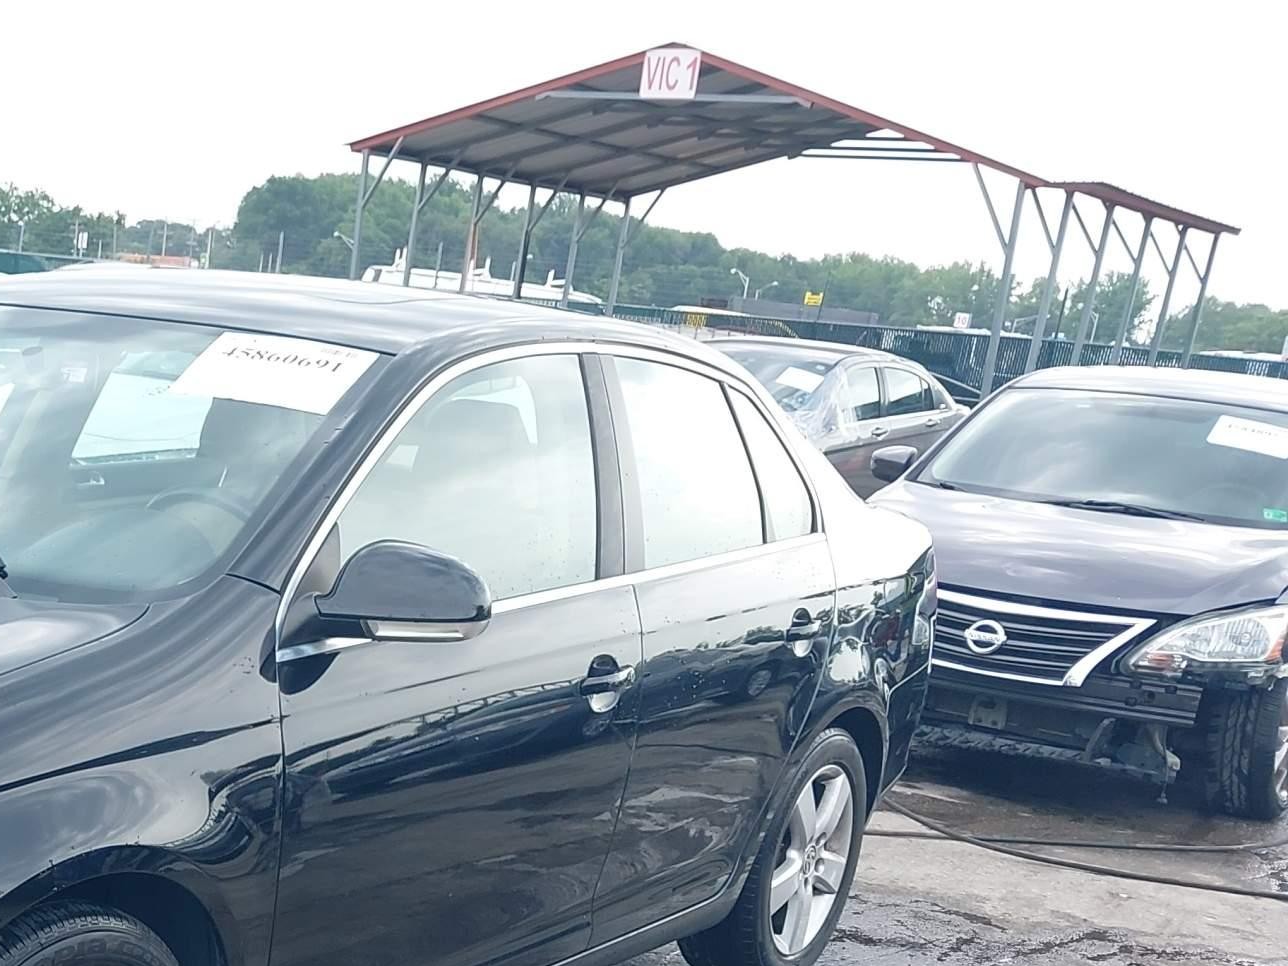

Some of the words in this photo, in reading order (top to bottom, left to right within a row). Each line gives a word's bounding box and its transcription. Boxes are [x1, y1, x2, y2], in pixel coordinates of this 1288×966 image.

[647, 55, 681, 91] VIC
[686, 56, 698, 91] 1
[223, 346, 345, 373] 45860691
